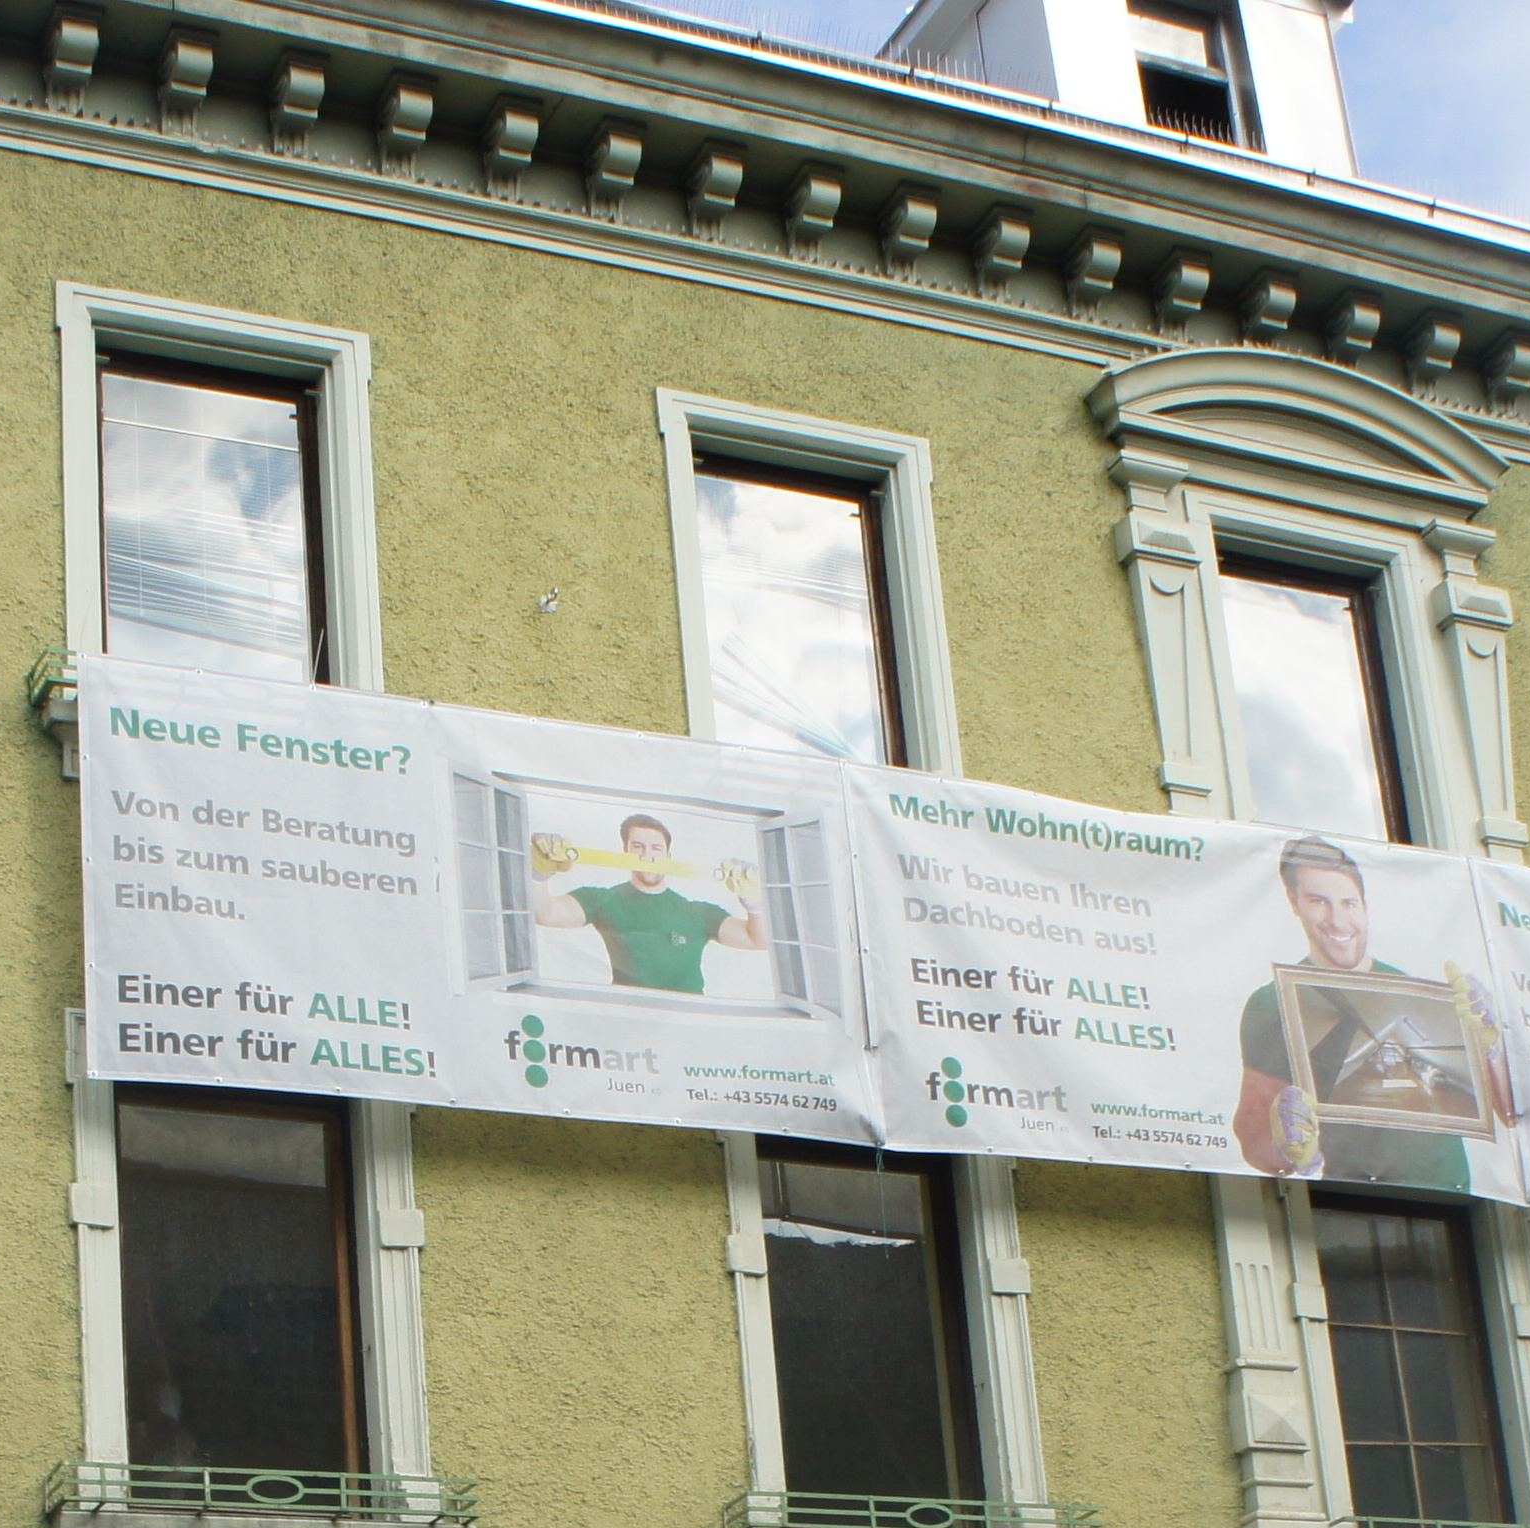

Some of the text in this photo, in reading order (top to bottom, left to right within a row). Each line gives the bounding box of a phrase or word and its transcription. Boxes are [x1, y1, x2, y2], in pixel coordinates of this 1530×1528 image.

[110, 707, 411, 775] Neue Fenster?
[111, 790, 416, 858] Von der Beratung
[888, 793, 1205, 862] Mehr Wohn(t)raum?
[112, 835, 418, 896] bis zum sauberen
[897, 853, 1151, 918] Wir bauen Ihren
[114, 883, 246, 920] Einbau.
[903, 896, 1158, 956] Dachboden aus!
[117, 974, 411, 1030] Einer für ALLE!
[910, 957, 1151, 1010] Einer für ALLE!
[119, 1022, 437, 1078] Einer für ALLES!
[916, 999, 1178, 1052] Einer für ALLES!
[607, 1077, 645, 1094] Juen
[683, 1063, 836, 1087] www.formart.at
[686, 1088, 837, 1112] Tel.: +43 5574 62 749
[1020, 1115, 1055, 1132] Juen
[1091, 1101, 1225, 1126] www.formart.at
[1092, 1125, 1228, 1148] Tel.: +43 5574 62 749
